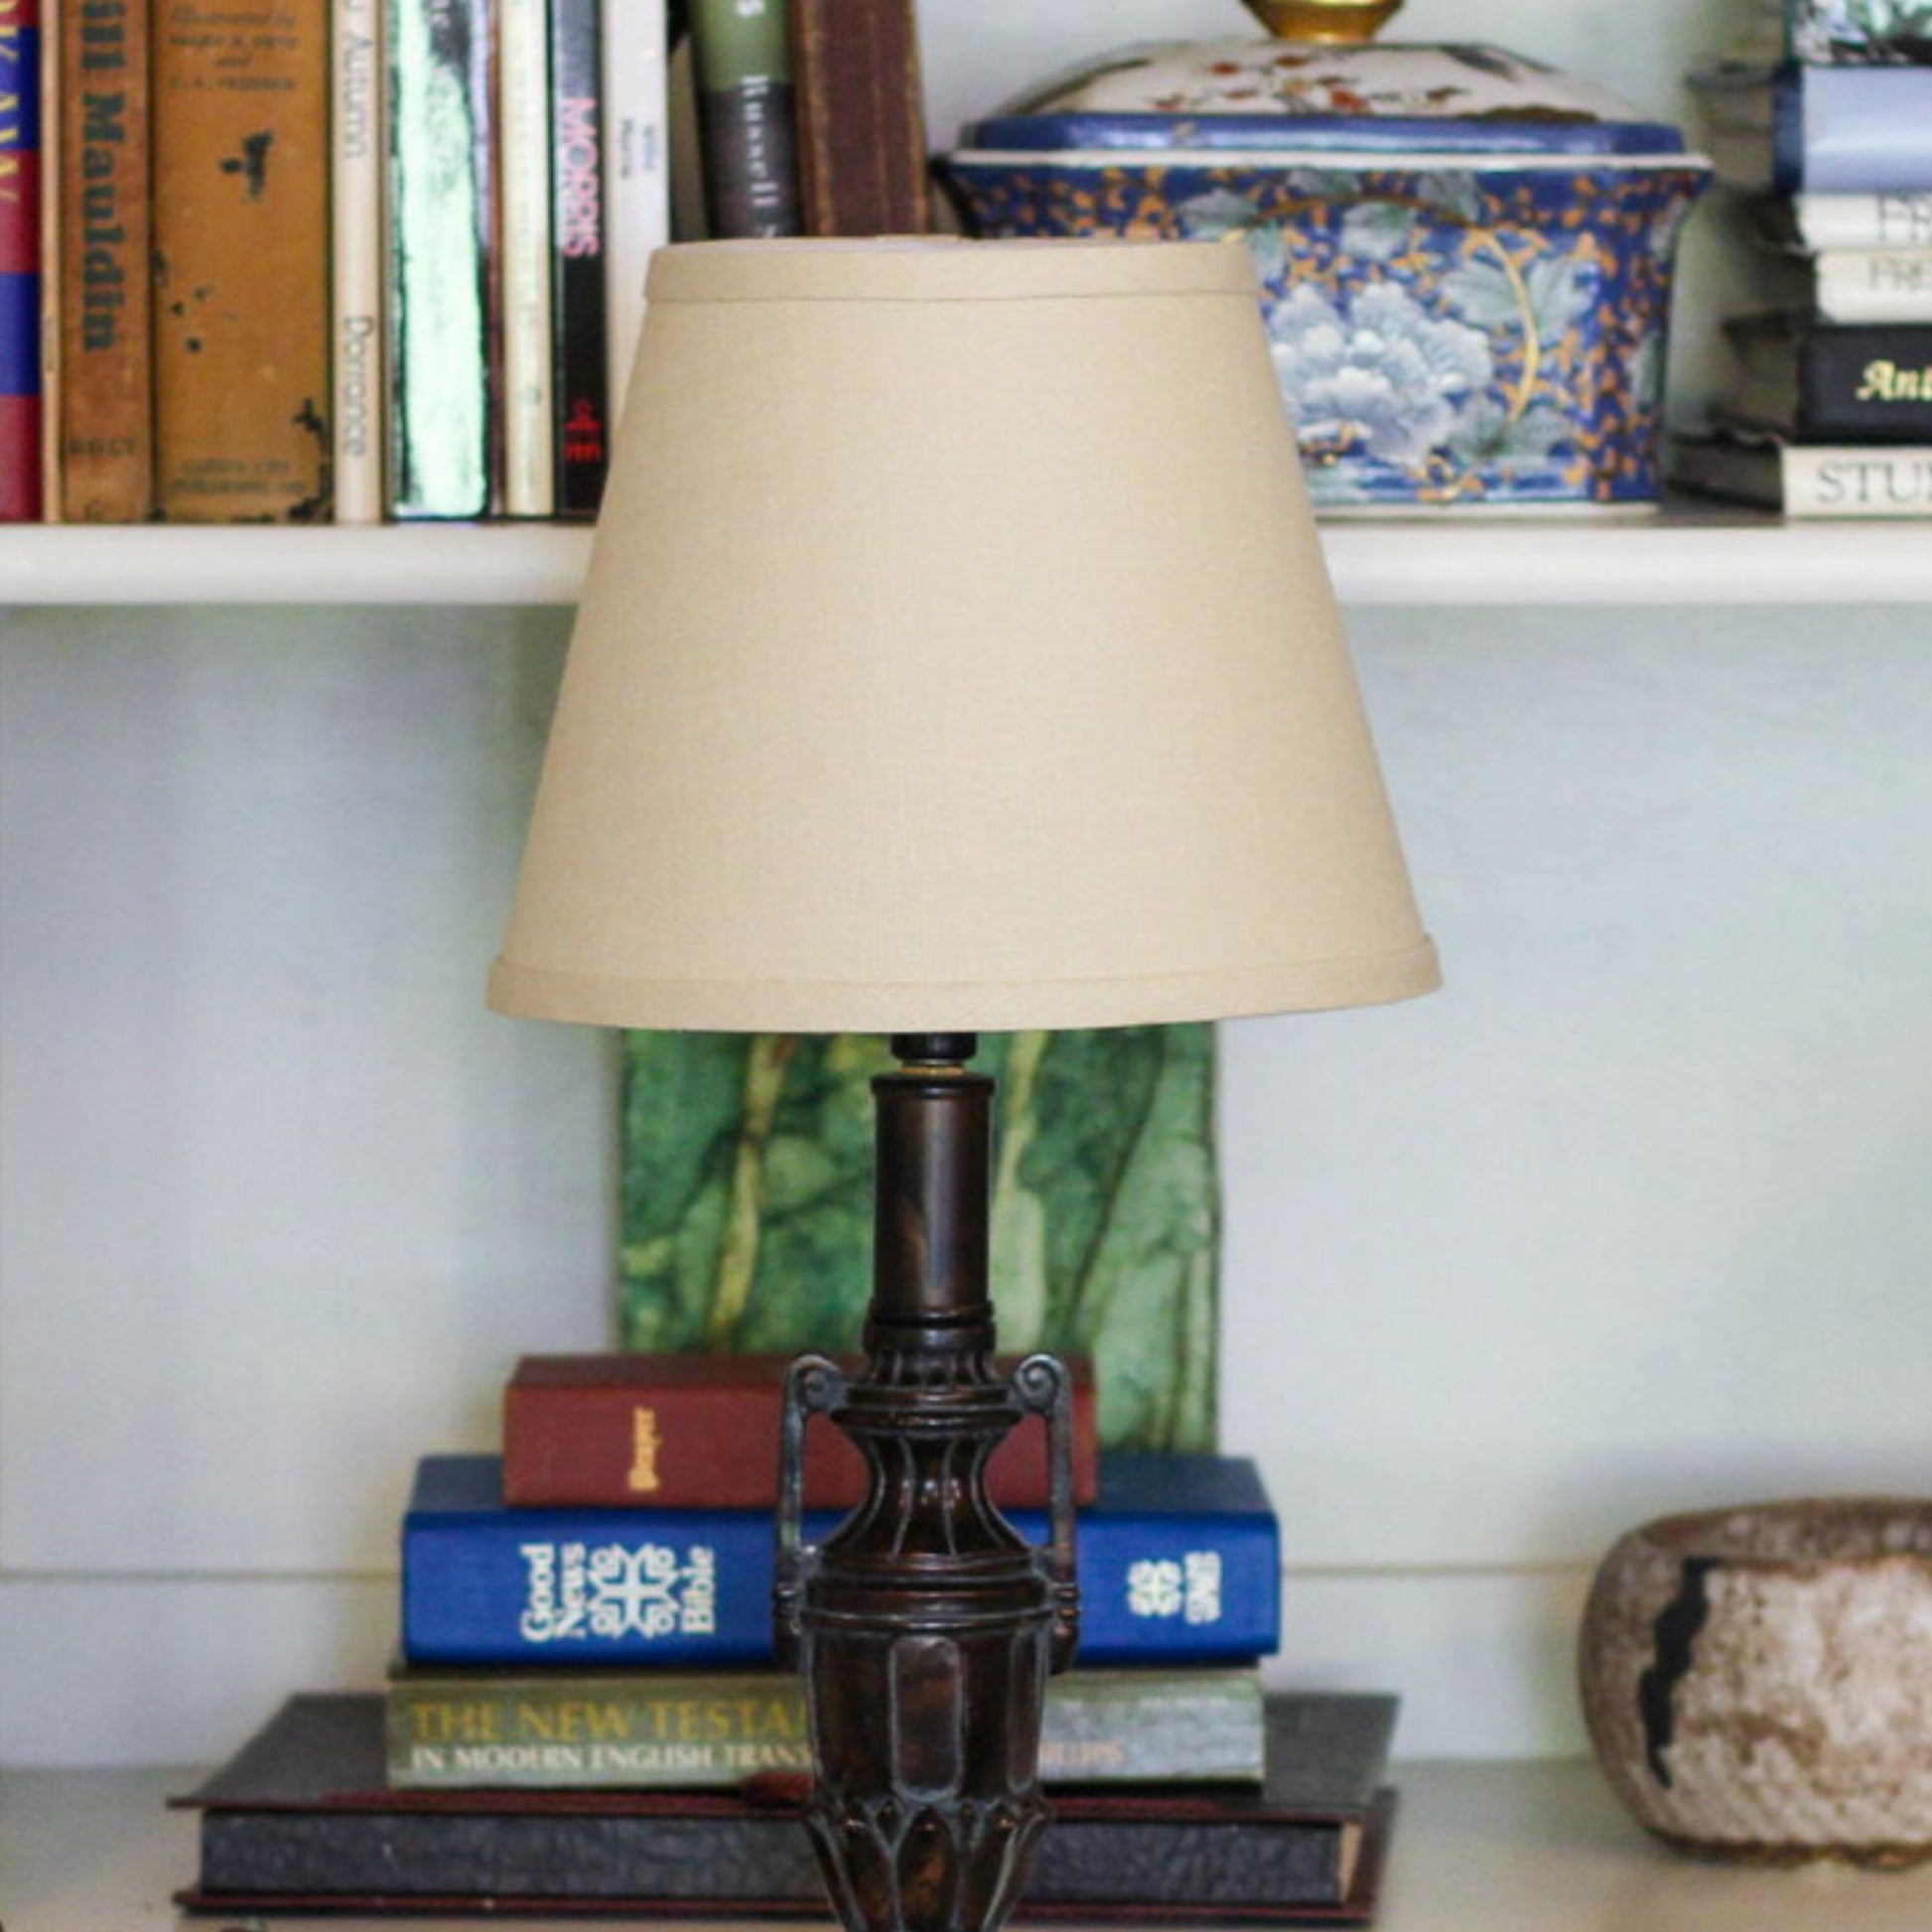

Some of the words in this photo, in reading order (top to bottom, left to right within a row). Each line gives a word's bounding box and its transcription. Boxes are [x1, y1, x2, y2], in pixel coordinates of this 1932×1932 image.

[344, 33, 373, 160] Autumn
[741, 74, 782, 207] Russell
[80, 92, 125, 350] Mauldin
[556, 97, 601, 258] MORRIS
[344, 316, 374, 457] Dorrance
[1817, 459, 1932, 502] STU
[519, 1541, 554, 1642] Good
[554, 1541, 587, 1640] News
[681, 1543, 716, 1634] Bible
[410, 1701, 499, 1740] THE
[517, 1701, 638, 1740] NEW
[647, 1699, 807, 1740] TESTA
[410, 1744, 446, 1770] IN
[453, 1744, 584, 1770] MODERN
[590, 1743, 712, 1769] ENGLISH
